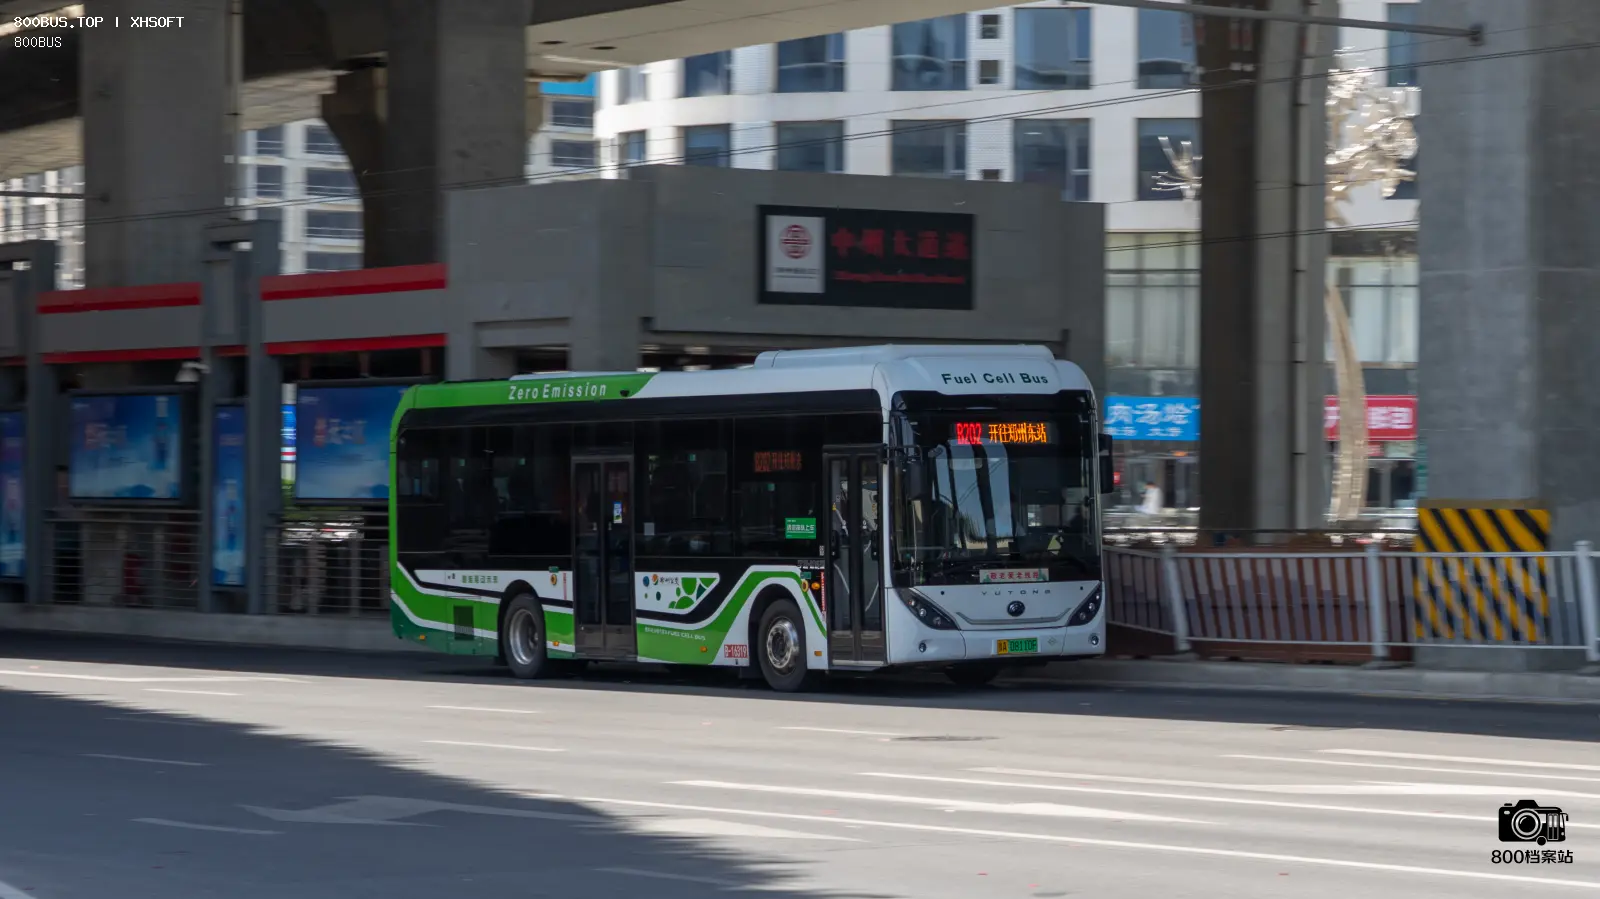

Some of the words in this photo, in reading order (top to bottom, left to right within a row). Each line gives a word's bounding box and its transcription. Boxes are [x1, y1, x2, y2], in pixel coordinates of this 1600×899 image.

[941, 372, 977, 385] Fuel
[982, 372, 1015, 384] Cell
[1019, 372, 1049, 384] Bus
[508, 385, 538, 400] Zero
[542, 383, 606, 399] Emission
[956, 422, 983, 445] B202
[988, 422, 1047, 444] 开往郑州东站
